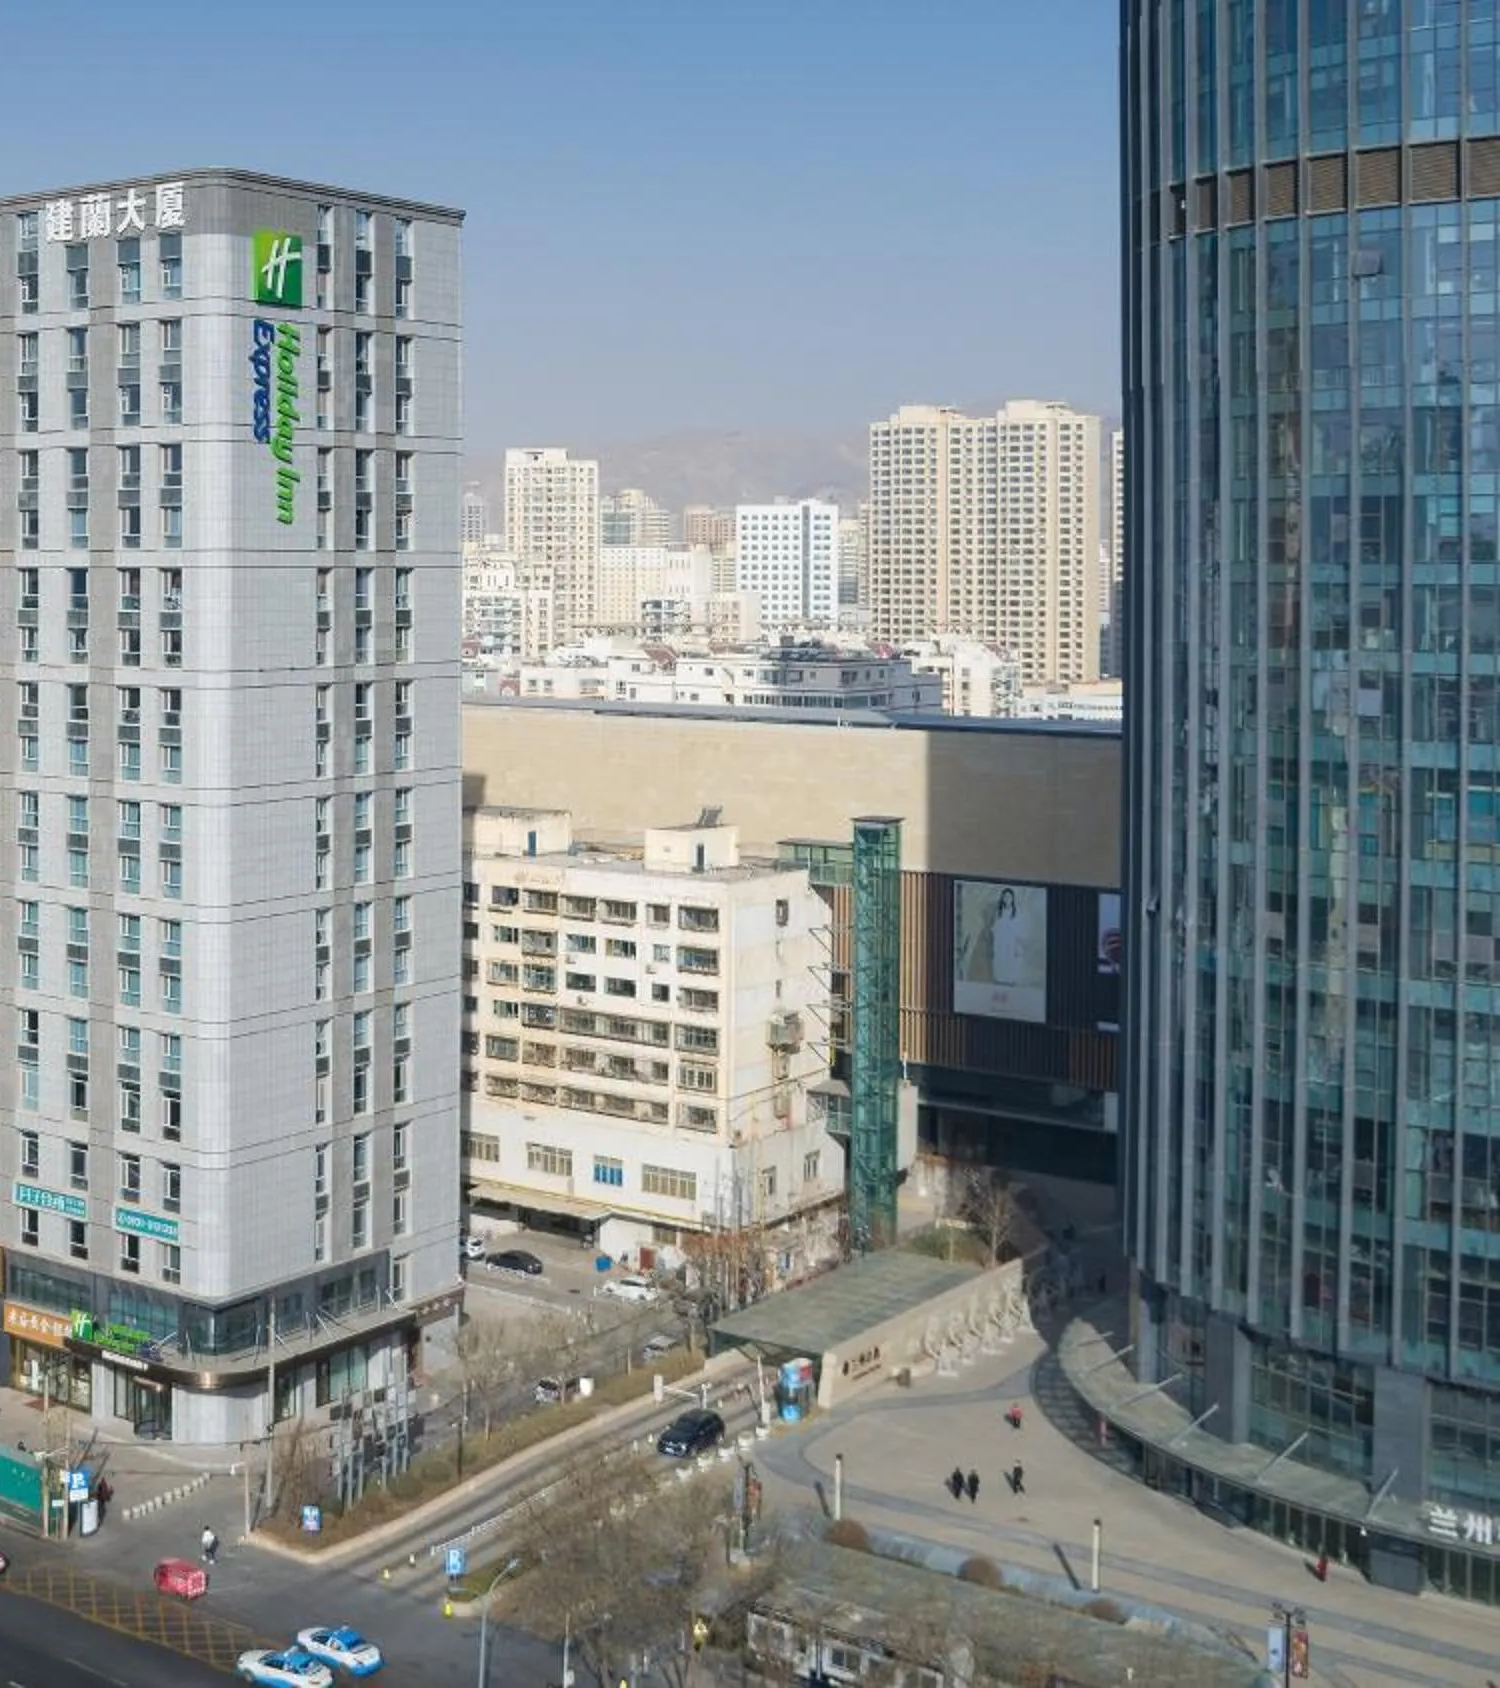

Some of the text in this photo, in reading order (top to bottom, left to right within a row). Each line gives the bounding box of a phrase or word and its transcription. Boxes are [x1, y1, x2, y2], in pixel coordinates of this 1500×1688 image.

[251, 318, 275, 445] Express
[271, 322, 301, 525] Holiday Inn
[1428, 1504, 1500, 1545] 兰州
